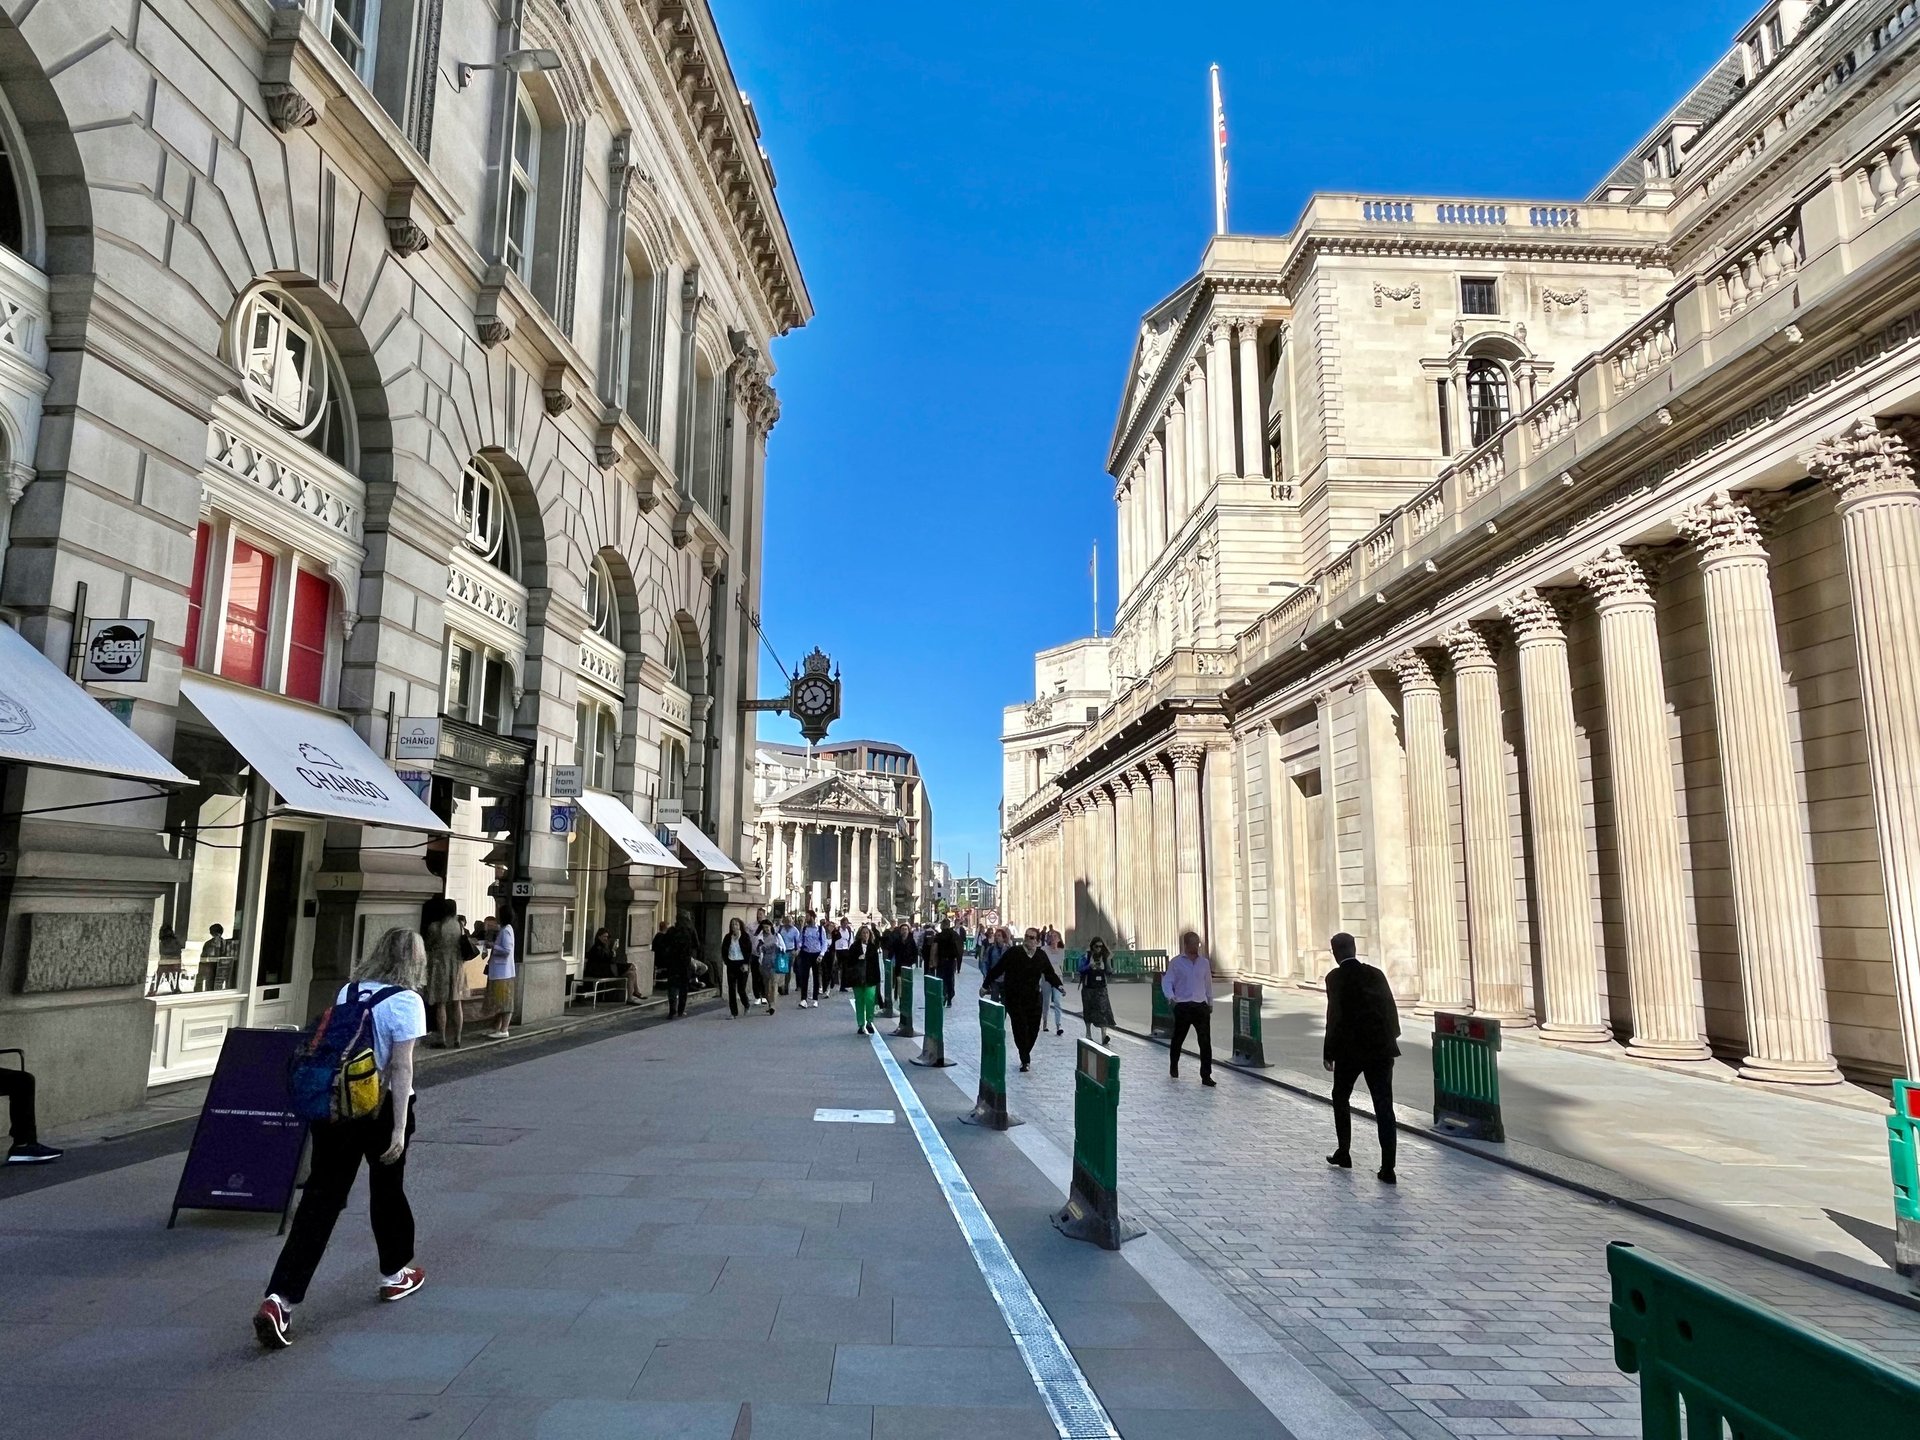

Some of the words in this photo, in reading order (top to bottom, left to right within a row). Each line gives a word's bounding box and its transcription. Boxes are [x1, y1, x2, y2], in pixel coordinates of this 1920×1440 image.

[91, 646, 141, 668] berry
[400, 736, 435, 746] CHANGO
[556, 769, 575, 777] buns
[296, 766, 390, 801] CHANGO
[555, 778, 574, 786] from
[622, 837, 666, 858] GRIND
[515, 884, 529, 895] 33
